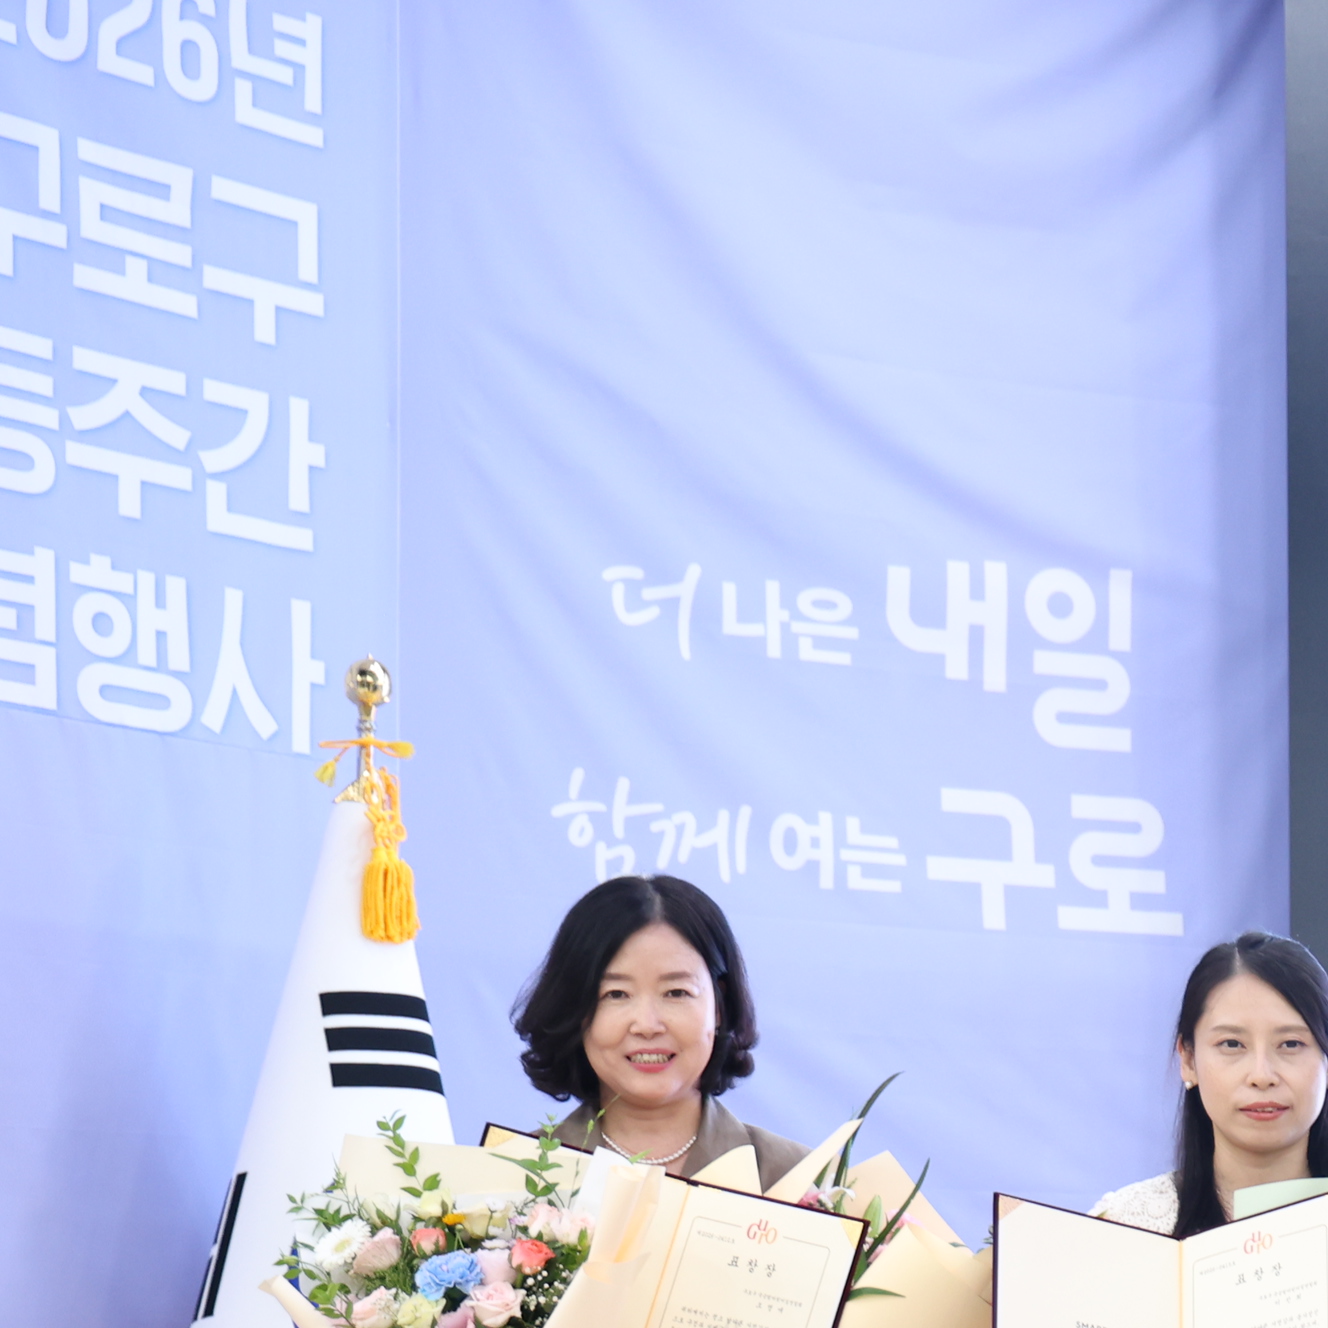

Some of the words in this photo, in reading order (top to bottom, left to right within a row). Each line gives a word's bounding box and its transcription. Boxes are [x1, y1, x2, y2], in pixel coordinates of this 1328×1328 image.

[0, 0, 324, 148] 026년
[602, 562, 701, 661] 더
[722, 579, 859, 666] 나은
[885, 559, 1133, 753] 내일
[550, 767, 752, 884] 함께
[769, 810, 908, 893] 여는
[925, 787, 1184, 936] 구로
